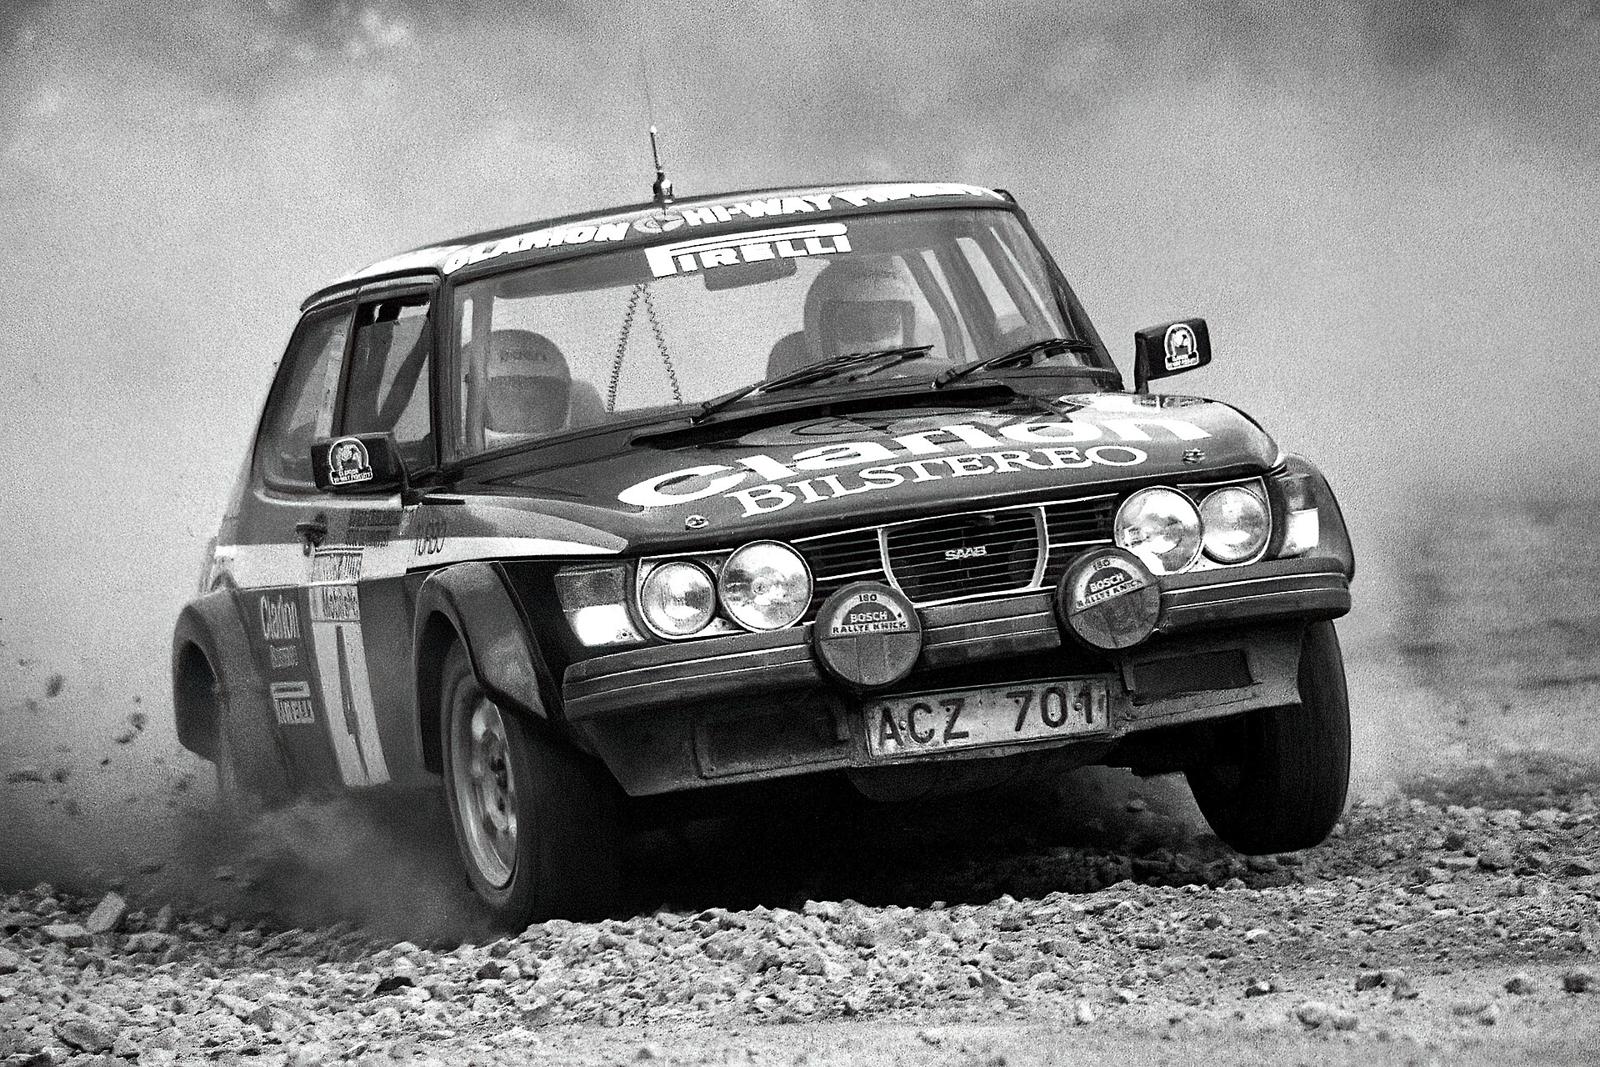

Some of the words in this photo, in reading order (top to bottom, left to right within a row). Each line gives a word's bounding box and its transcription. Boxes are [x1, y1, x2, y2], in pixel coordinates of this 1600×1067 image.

[644, 221, 852, 279] PIRELLI
[617, 415, 1213, 510] Clarion
[723, 445, 1149, 518] BILSTEREO
[944, 545, 988, 561] SAAB
[1089, 572, 1125, 593] BOSCH
[850, 611, 888, 623] BOSCH
[877, 697, 970, 748] ACZ
[1006, 682, 1095, 733] 701
